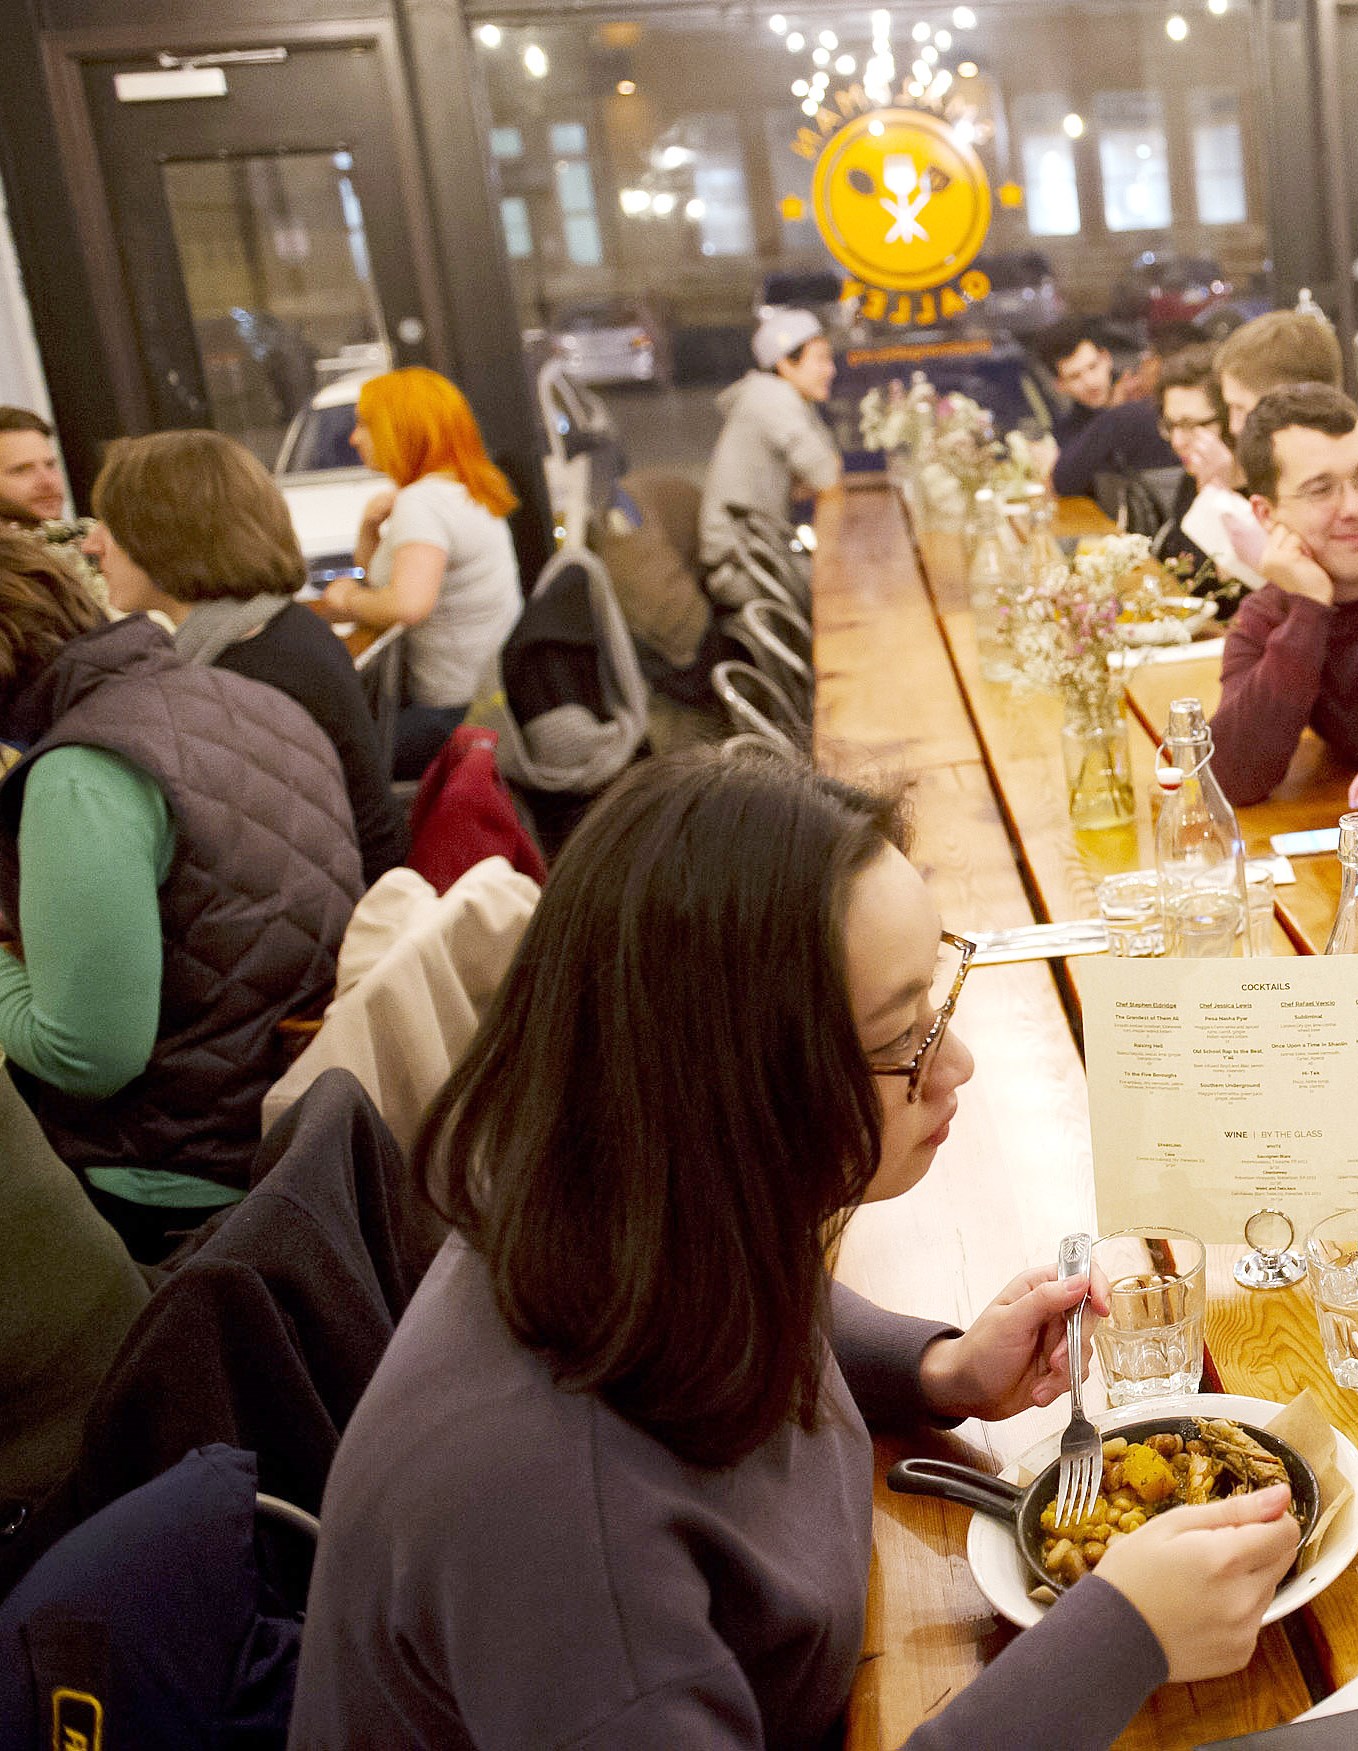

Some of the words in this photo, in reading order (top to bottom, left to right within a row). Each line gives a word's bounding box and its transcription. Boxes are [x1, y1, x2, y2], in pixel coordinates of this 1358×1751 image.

[1241, 983, 1291, 991] COCKTAILS
[1153, 1002, 1177, 1010] Eldridge
[1224, 1131, 1248, 1139] WINE
[1261, 1131, 1273, 1139] BY
[1275, 1131, 1292, 1139] THE
[1294, 1130, 1323, 1138] GLASS
